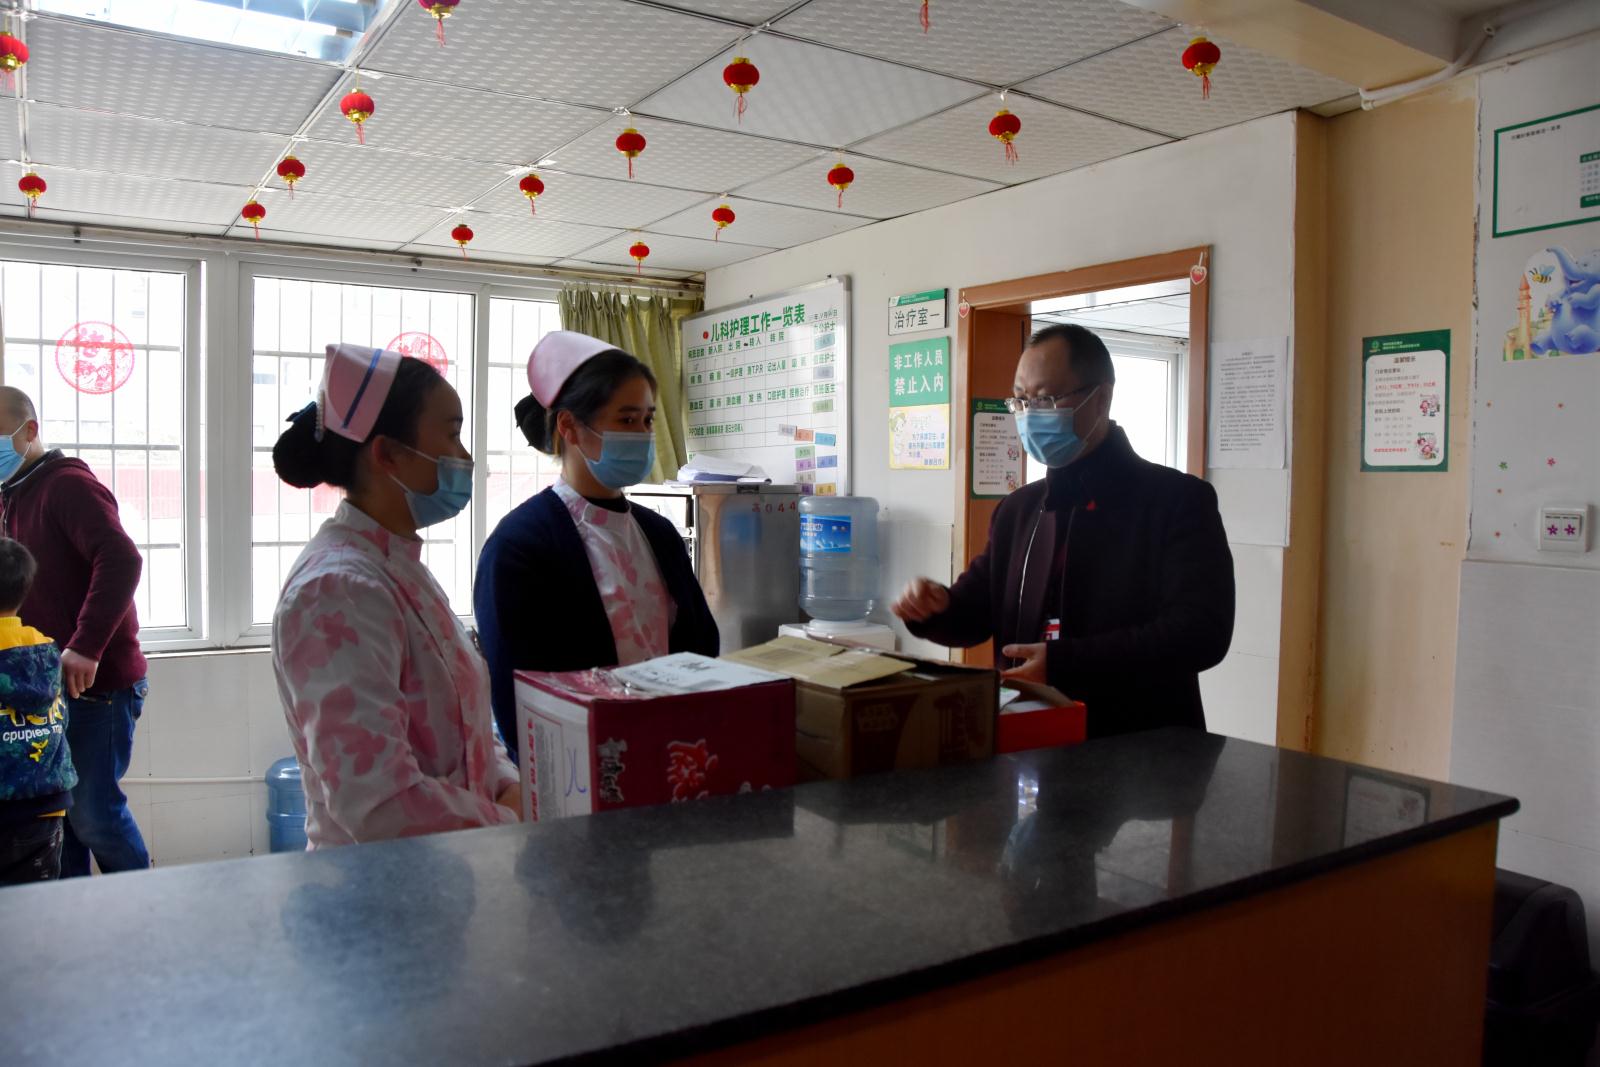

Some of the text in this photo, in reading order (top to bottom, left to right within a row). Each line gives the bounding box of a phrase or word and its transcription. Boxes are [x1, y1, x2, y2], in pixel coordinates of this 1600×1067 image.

[710, 303, 806, 343] 儿科护理工作一览表
[894, 308, 940, 329] 治疗室一
[893, 349, 944, 370] 非工作人员
[893, 372, 944, 396] 禁止入内
